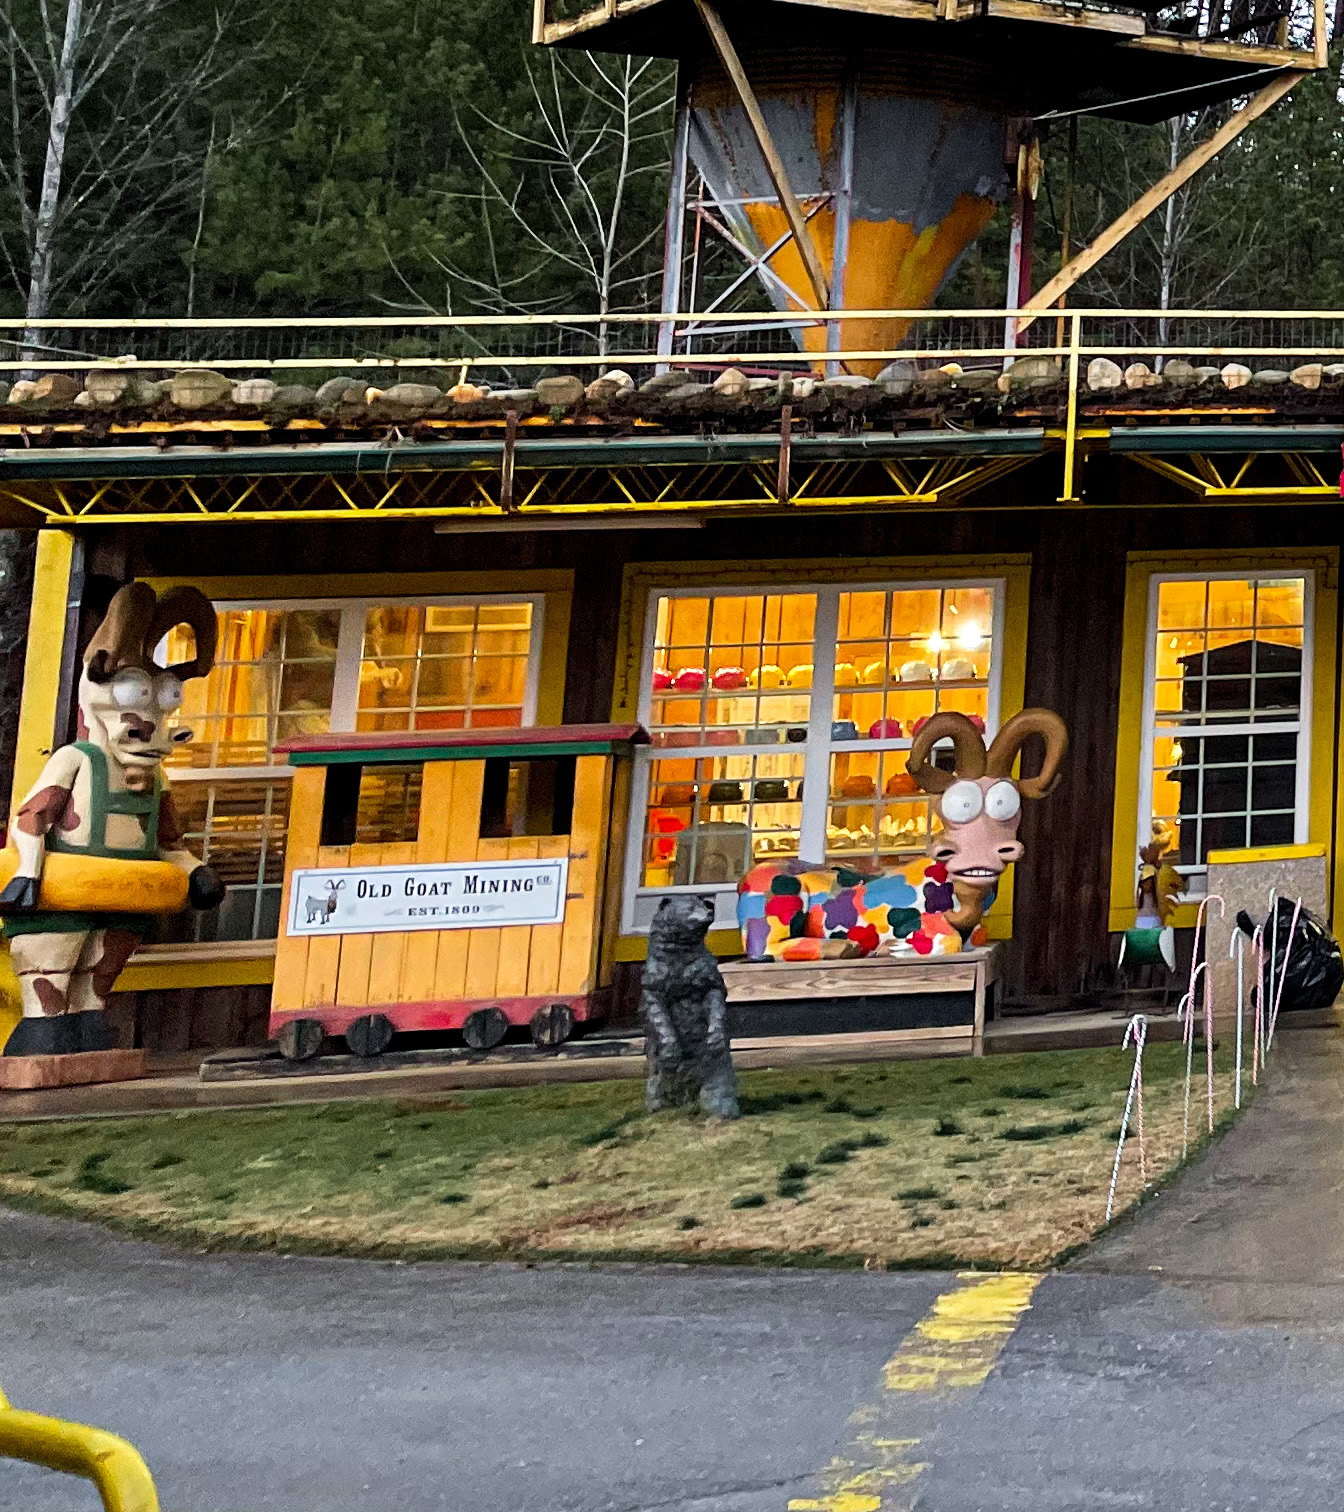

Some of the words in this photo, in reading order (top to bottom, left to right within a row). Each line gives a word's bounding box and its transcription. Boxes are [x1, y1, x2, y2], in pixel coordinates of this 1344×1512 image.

[357, 879, 392, 899] OLD
[404, 877, 453, 897] GOAT
[463, 875, 534, 895] MINING
